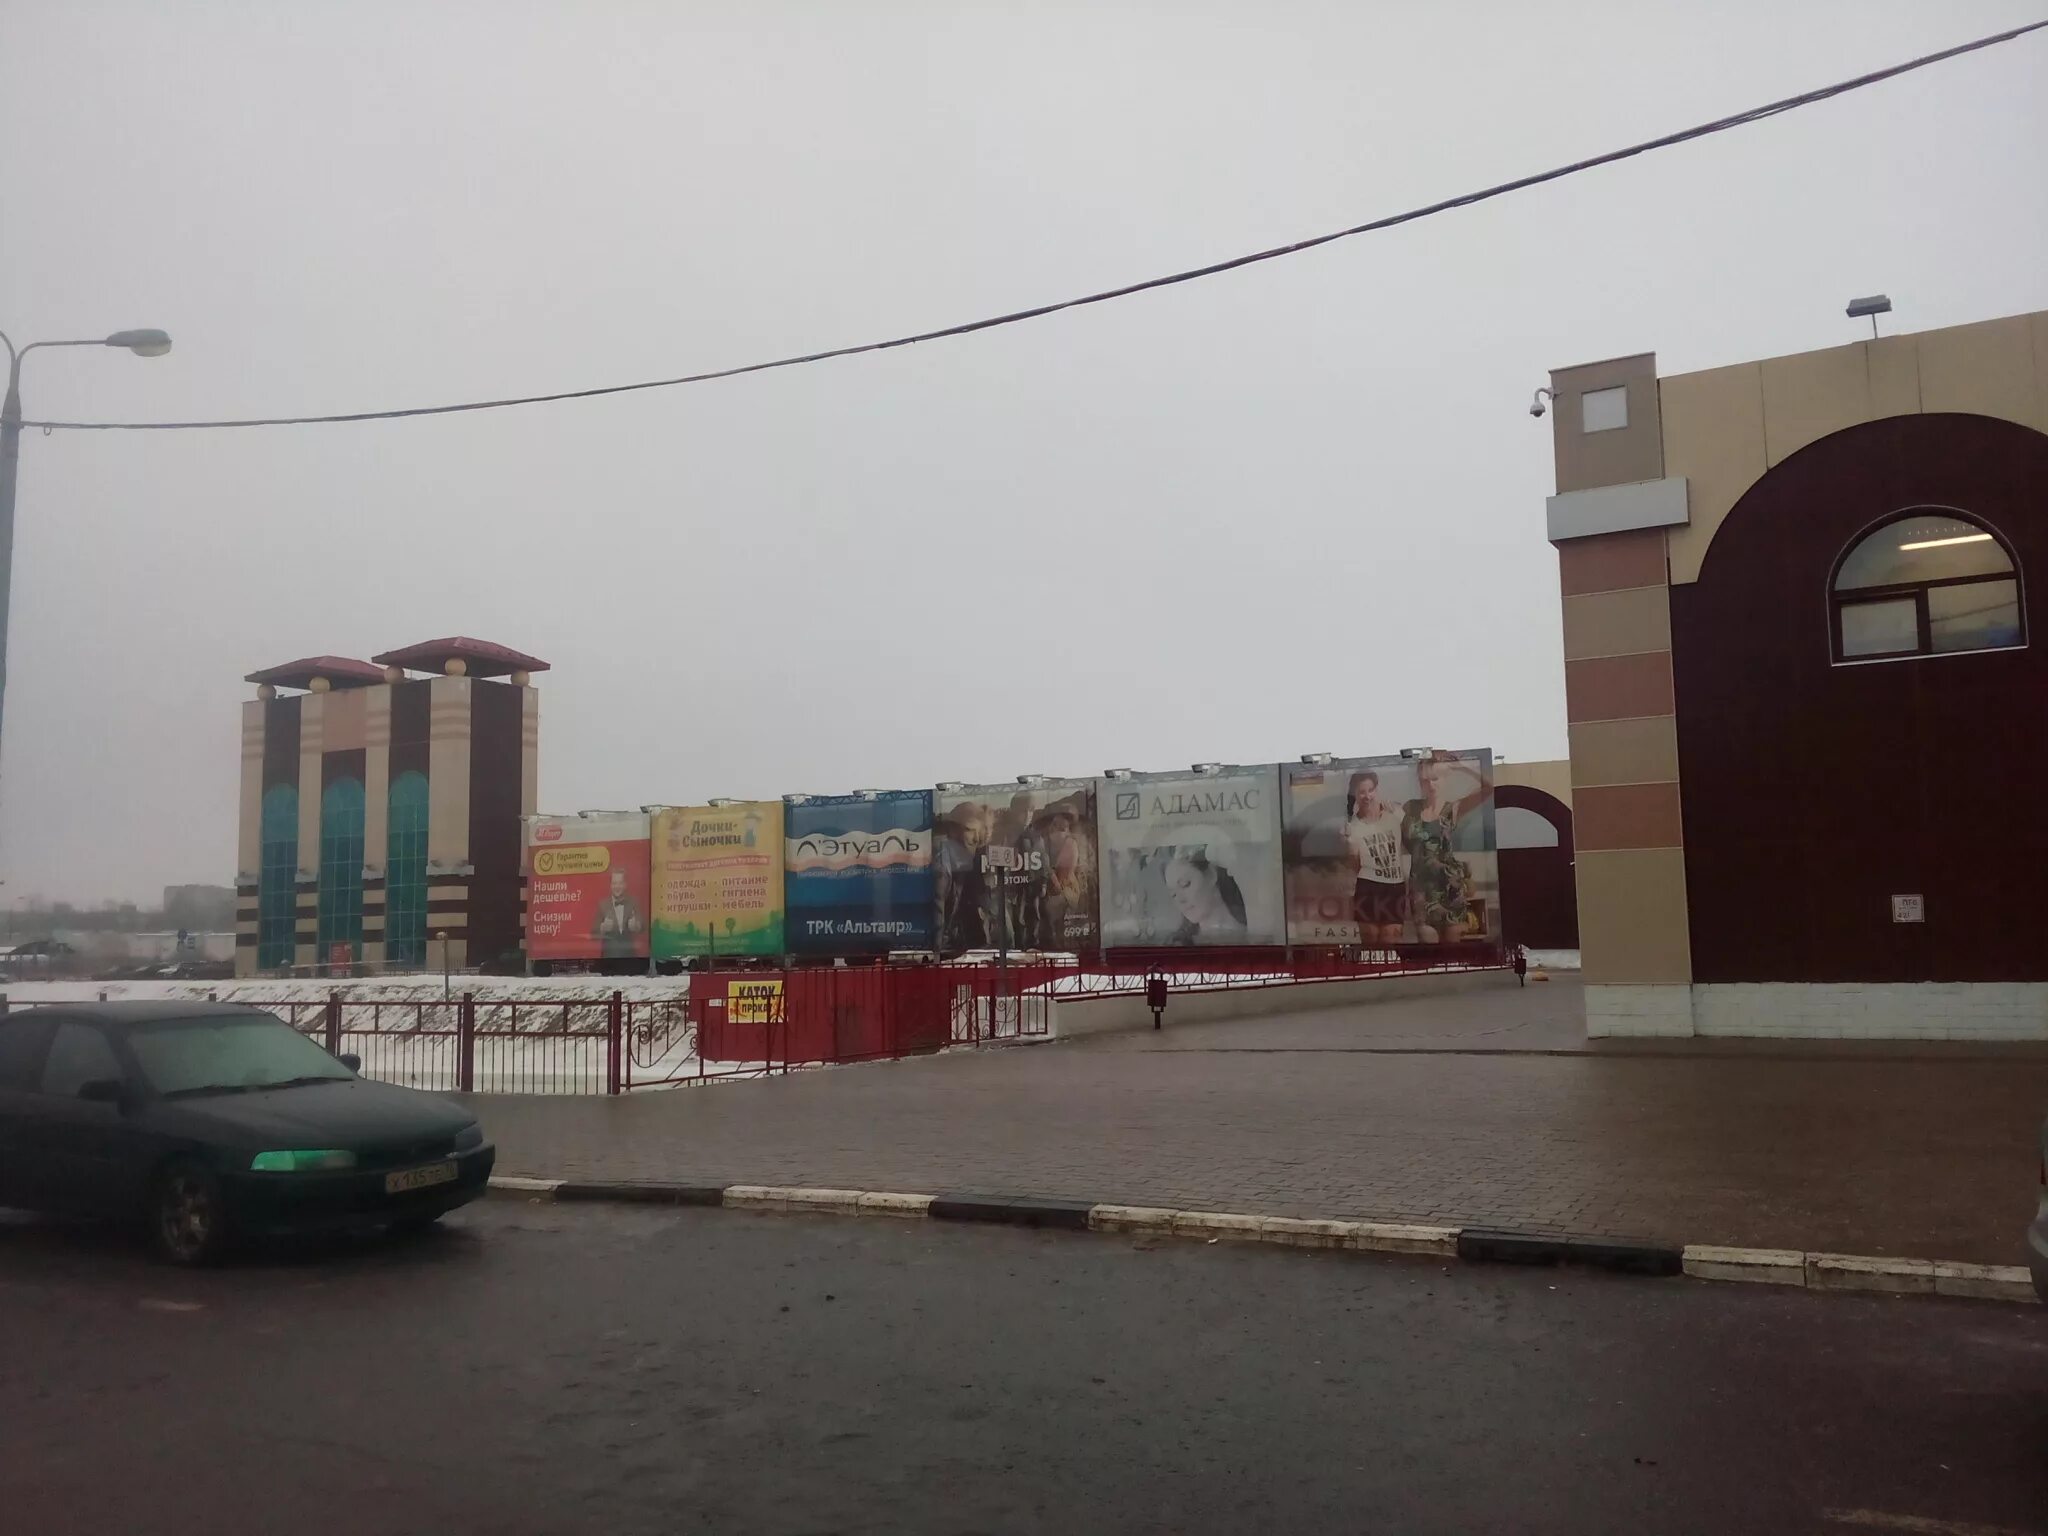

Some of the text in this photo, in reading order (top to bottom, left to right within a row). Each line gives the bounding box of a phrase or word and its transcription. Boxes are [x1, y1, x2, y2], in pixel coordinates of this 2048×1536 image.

[1151, 789, 1260, 815] АДАМАС
[682, 834, 742, 848] Сыночки
[981, 851, 1042, 873] MDIS
[534, 880, 568, 891] Нашли
[667, 879, 706, 890] одежда
[722, 876, 768, 887] питание
[533, 889, 582, 904] дешевле?
[667, 891, 695, 901] обувь
[722, 888, 766, 898] гигиена
[667, 902, 711, 913] игрушки
[722, 899, 764, 910] мебель
[533, 910, 572, 922] Снизим
[534, 919, 561, 936] цену!
[806, 919, 913, 937] ТРК «Альтаир»
[738, 986, 776, 1000] КАТОК
[741, 1003, 772, 1013] ПРОКА
